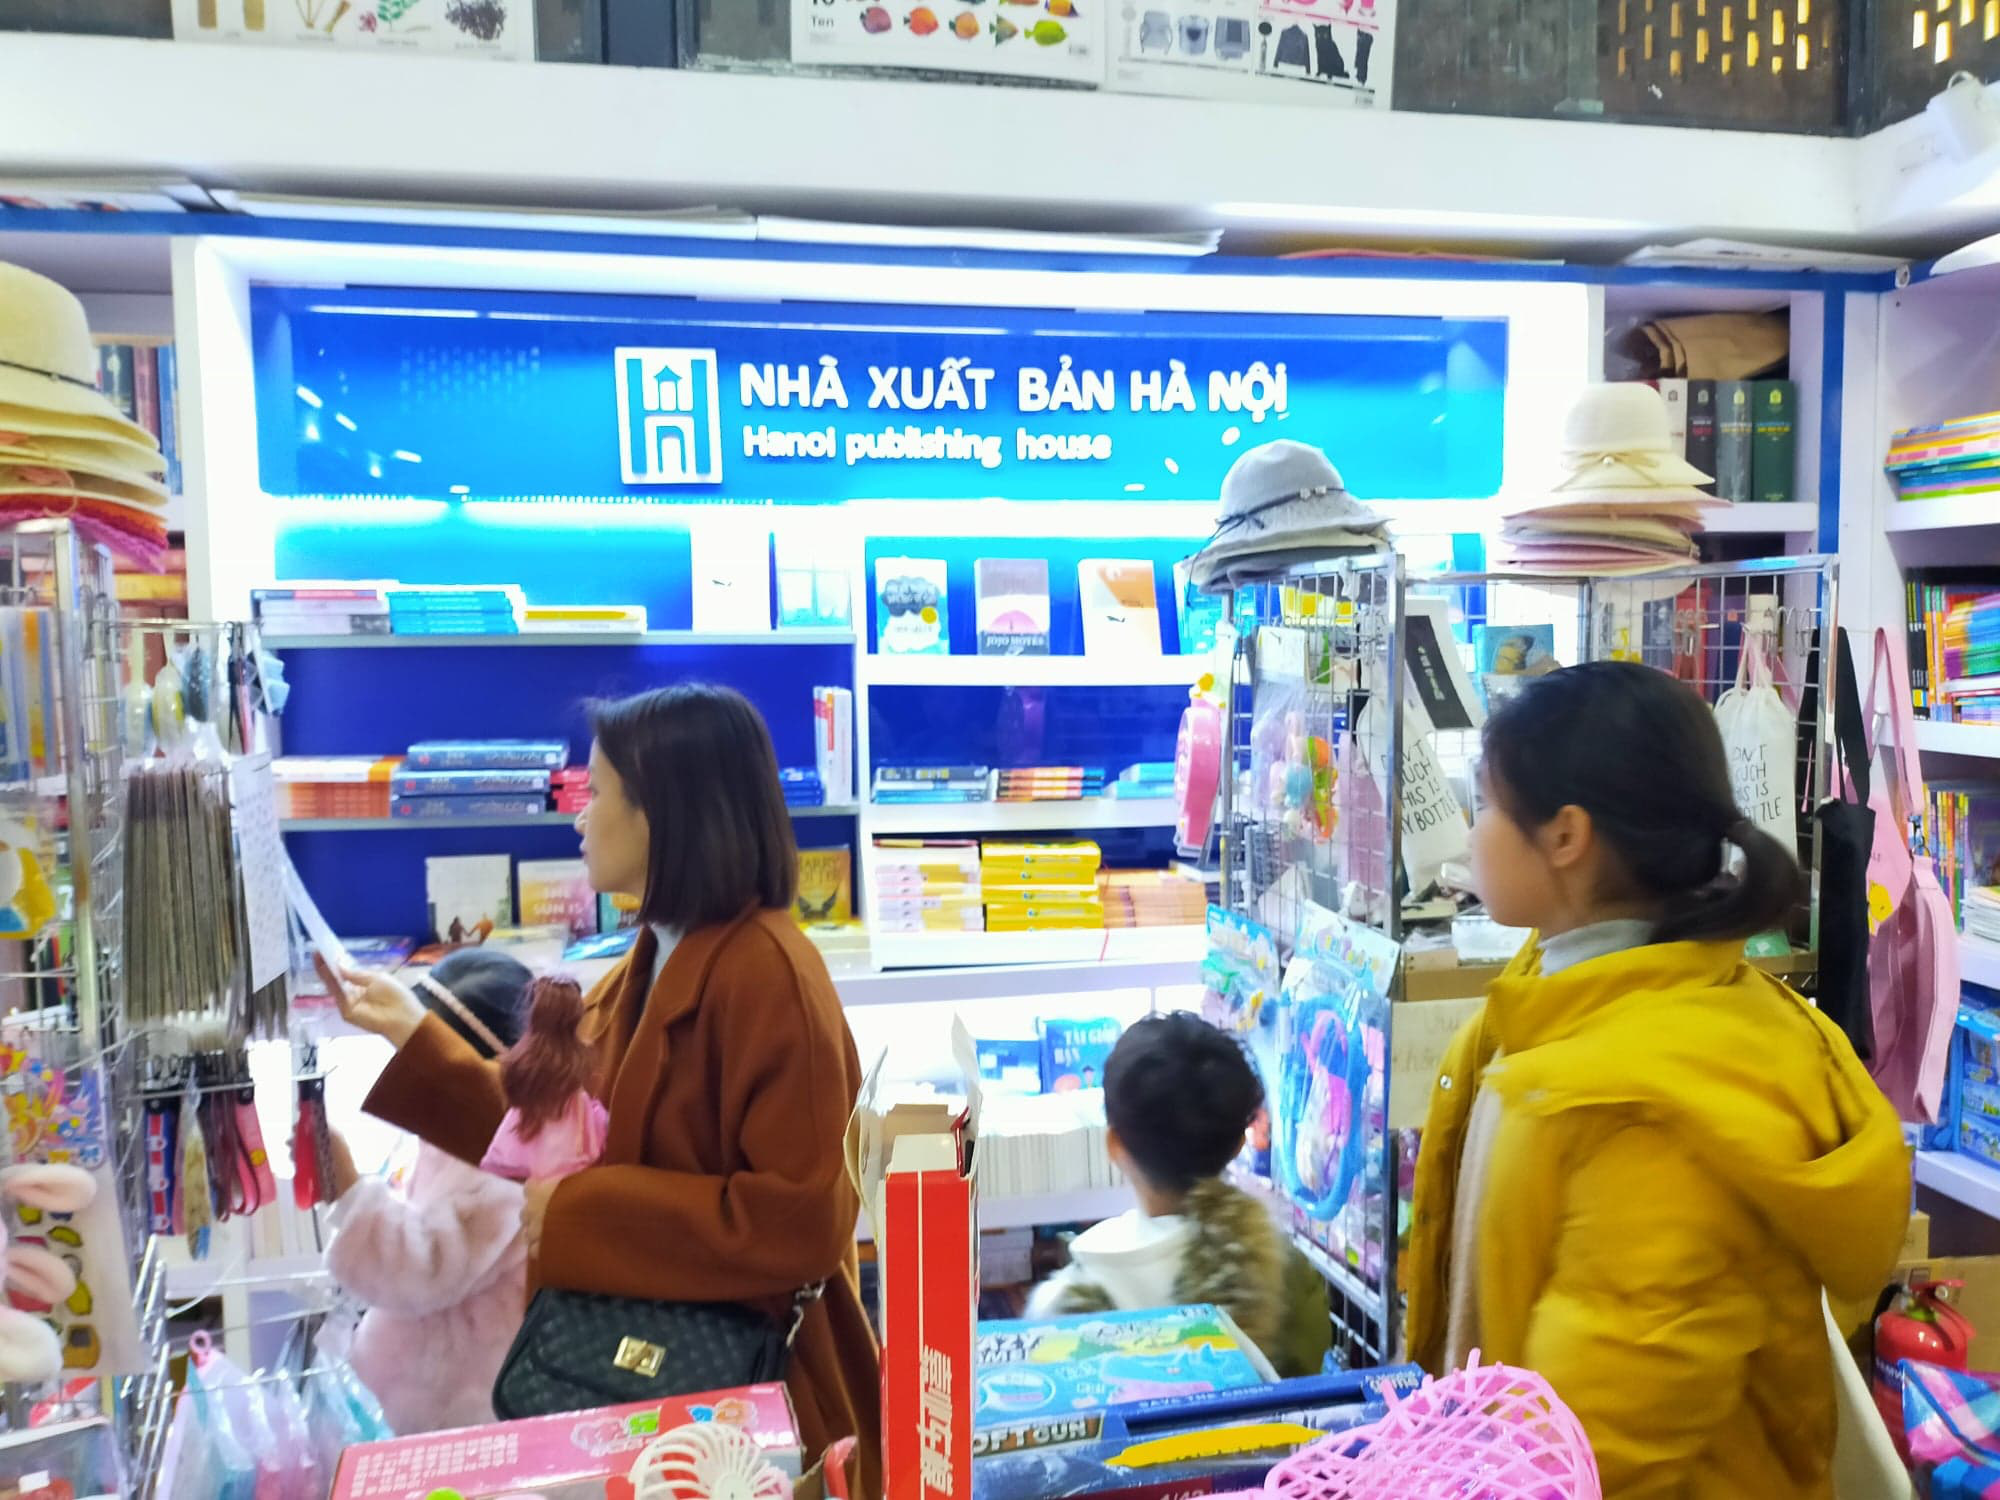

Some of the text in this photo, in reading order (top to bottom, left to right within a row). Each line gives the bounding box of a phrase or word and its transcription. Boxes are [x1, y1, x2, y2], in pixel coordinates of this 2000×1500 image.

[811, 15, 835, 28] Ten
[740, 354, 1287, 423] NHÀ XUẤT BẢN HÀ NỘI
[743, 425, 1112, 468] Hanoi publishing house
[1755, 781, 1769, 798] IS
